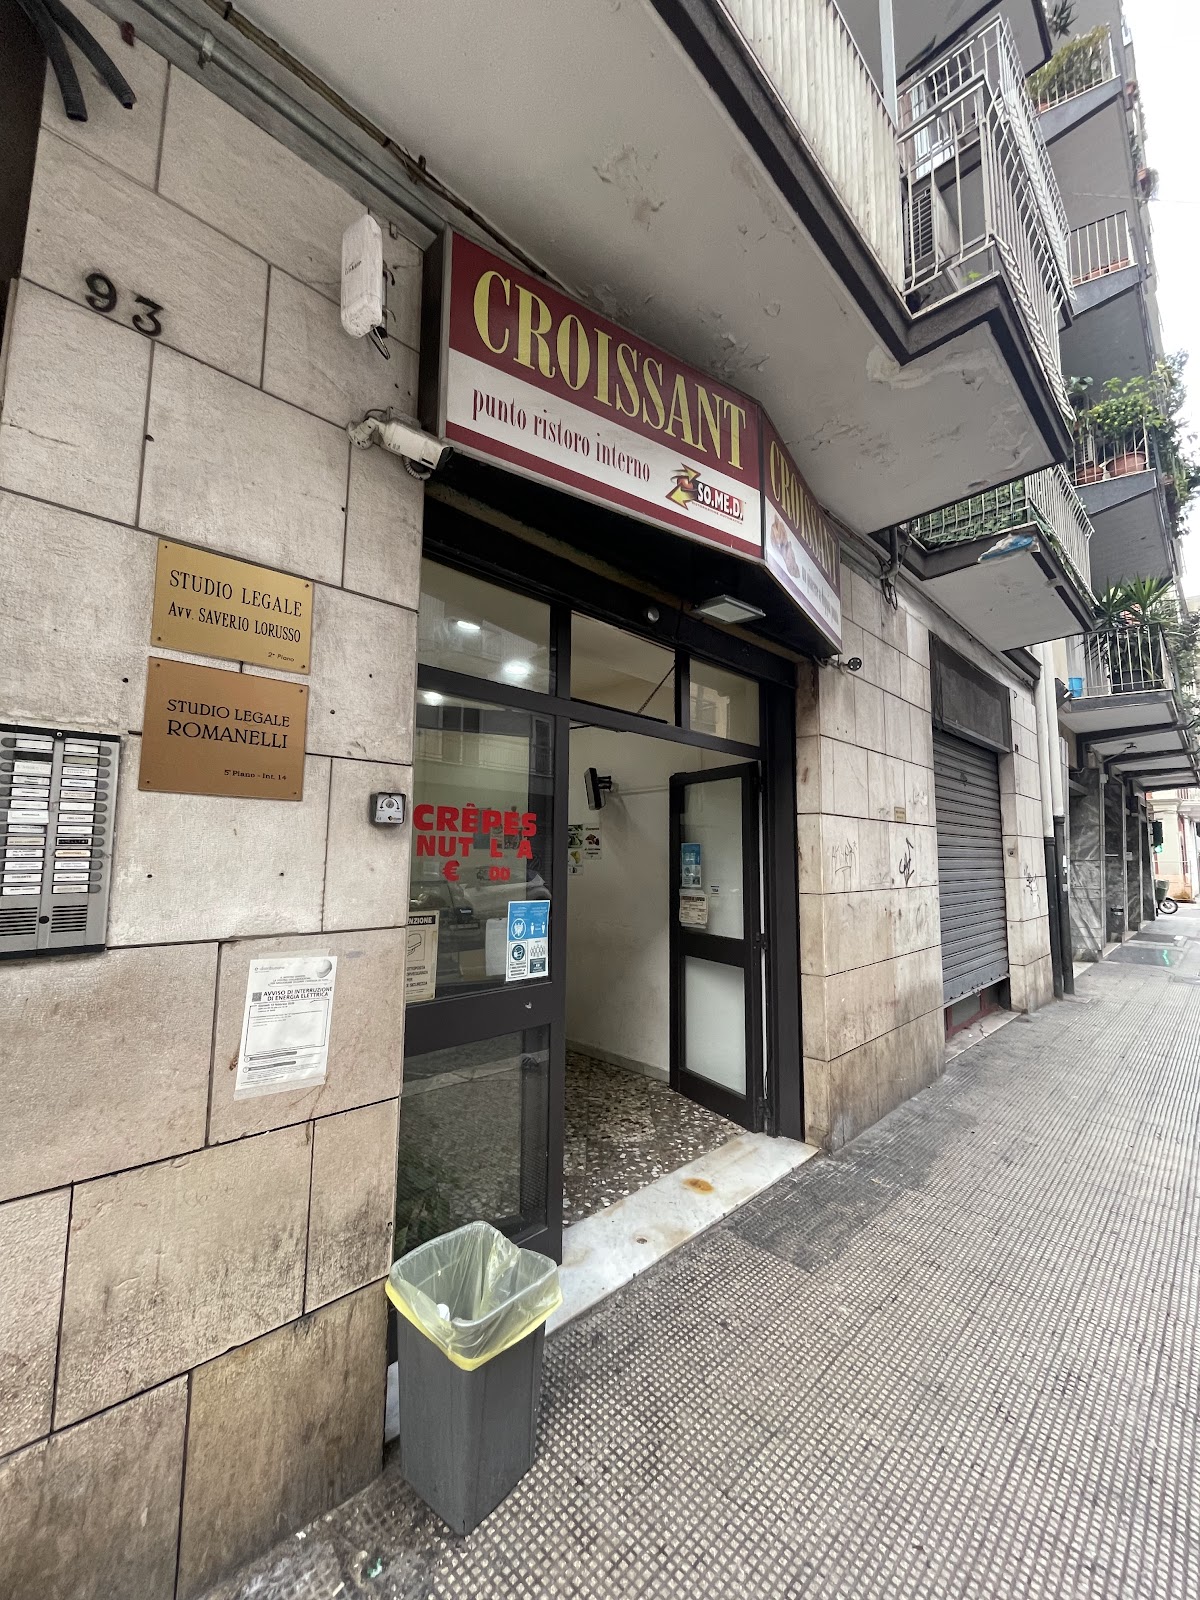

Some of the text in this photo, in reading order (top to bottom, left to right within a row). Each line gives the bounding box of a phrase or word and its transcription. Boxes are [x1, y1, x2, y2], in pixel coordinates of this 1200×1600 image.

[84, 272, 164, 337] 93
[473, 270, 746, 470] CROISSANT
[472, 388, 650, 482] punto ristoro interno
[769, 440, 839, 587] CROISSANT
[170, 569, 303, 617] STUDIO LEGALE
[168, 601, 301, 643] Avv. SAVERIO LORUSSO
[277, 654, 295, 662] Piano
[166, 699, 290, 728] STUDIO LEGALE
[166, 719, 288, 749] ROMANELLI
[232, 770, 256, 778] Piano
[413, 803, 537, 837] CRÊPES
[442, 860, 460, 882] €
[263, 990, 286, 998] AVVISO
[294, 986, 333, 995] INTERRUZIONE
[275, 993, 299, 1001] ENERGIA
[300, 991, 329, 999] ELETTRICA
